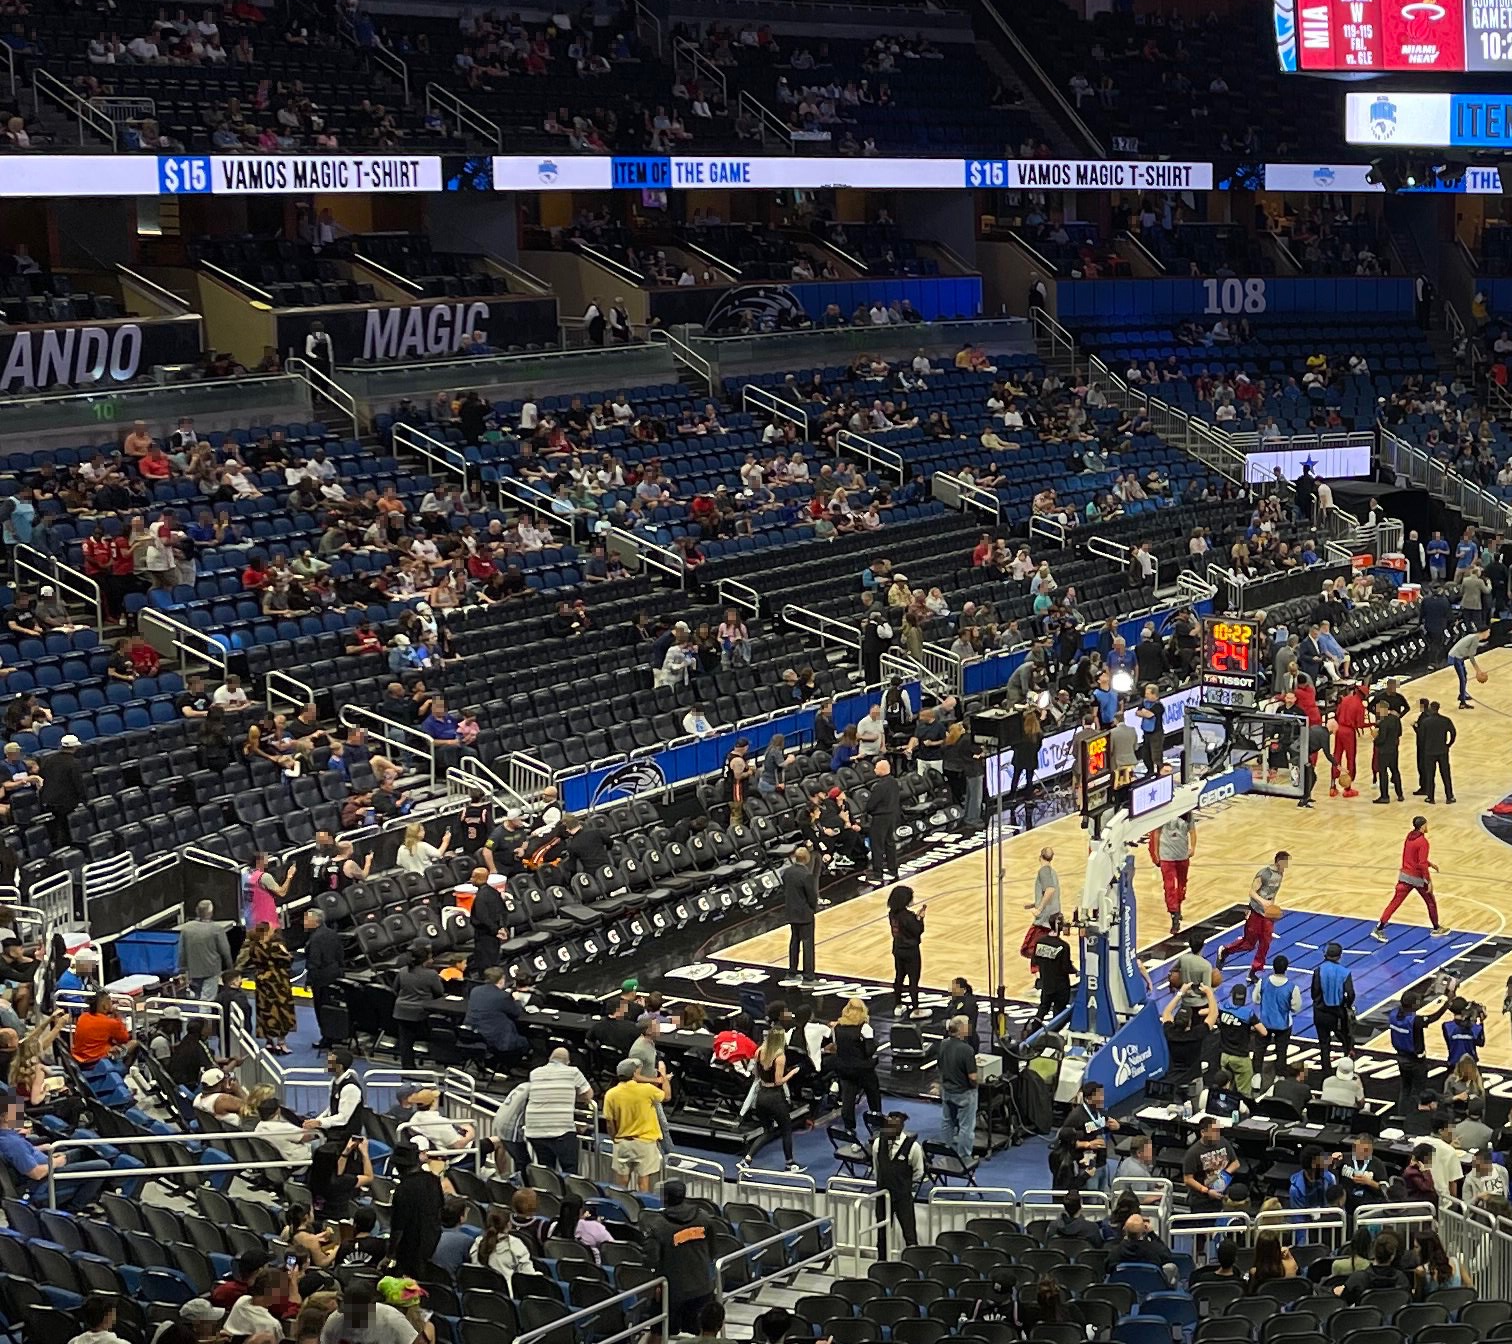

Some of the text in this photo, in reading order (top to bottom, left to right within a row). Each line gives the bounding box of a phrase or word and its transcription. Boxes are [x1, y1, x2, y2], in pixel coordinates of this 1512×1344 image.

[1349, 3, 1364, 24] W
[1302, 4, 1330, 50] MIA
[1401, 43, 1440, 56] MIAMI
[164, 158, 419, 193] $15 VAMOS MAGIC T-SHIRT
[613, 162, 751, 184] ITEM OF THE GAME
[970, 162, 1192, 188] $15 VAMOS MAGIC T-SHIRT
[1471, 171, 1500, 190] THE
[1203, 278, 1267, 314] 108
[363, 302, 490, 359] MAGIC
[0, 323, 143, 389] ANDO
[1213, 623, 1253, 645] 10:22
[1211, 639, 1249, 671] 24
[1217, 675, 1255, 688] TISSOT
[1200, 782, 1236, 807] GEICO
